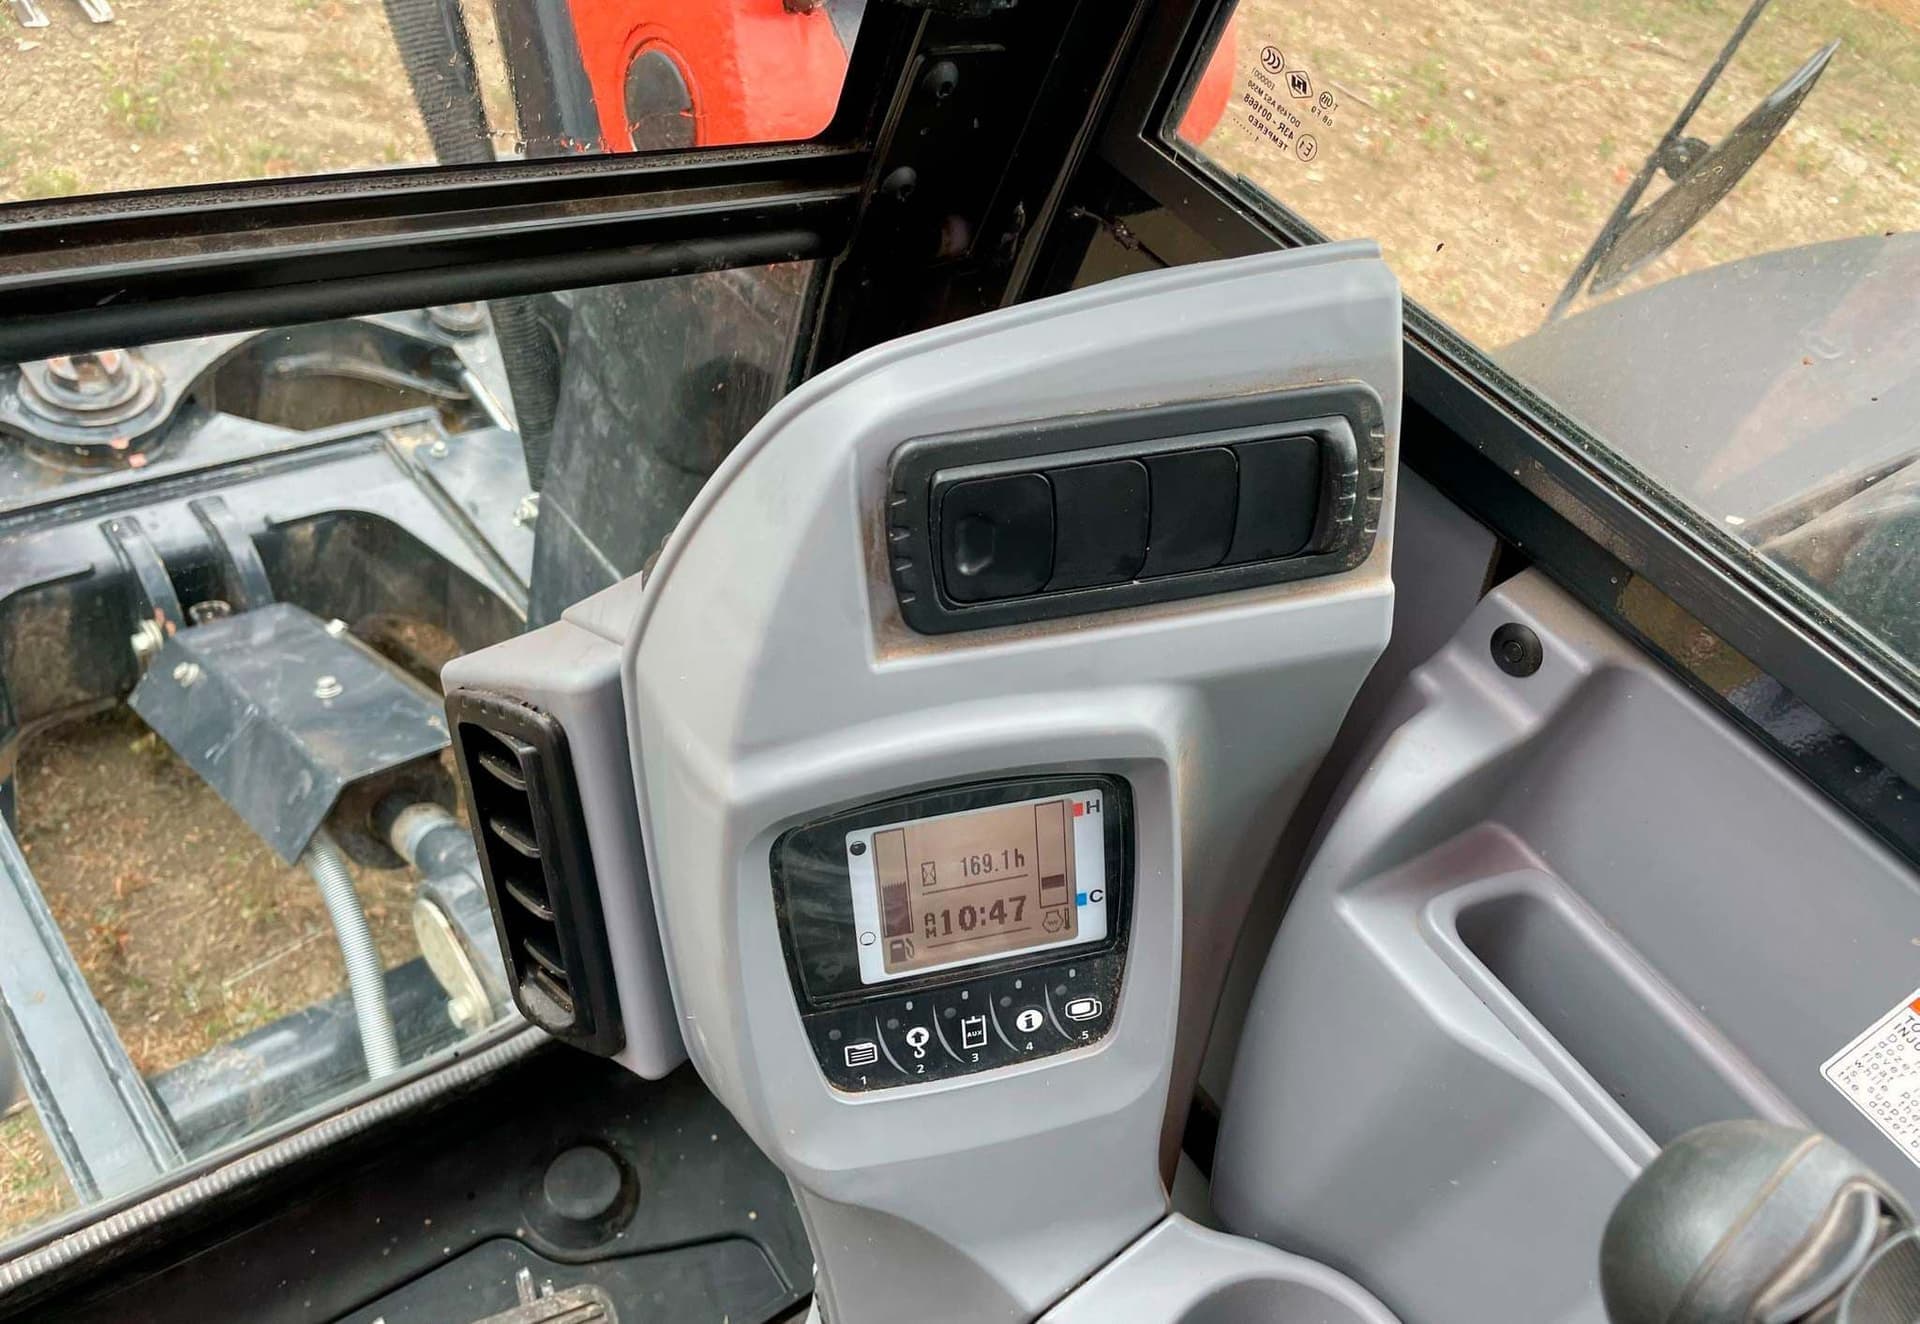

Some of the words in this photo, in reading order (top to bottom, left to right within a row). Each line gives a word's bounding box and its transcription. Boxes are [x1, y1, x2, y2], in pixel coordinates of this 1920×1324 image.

[1086, 799, 1100, 815] H
[1089, 889, 1104, 903] C
[941, 895, 1027, 936] 10:47
[967, 1031, 983, 1039] AUX
[1081, 1031, 1089, 1039] 5
[1025, 1041, 1034, 1051] 4
[971, 1053, 980, 1063] 3
[1878, 1041, 1918, 1076] dozer
[916, 1065, 925, 1074] 2
[860, 1076, 868, 1085] 1
[1838, 1071, 1859, 1091] the
[1869, 1101, 1907, 1135] dozer
[1867, 1086, 1920, 1137] support
